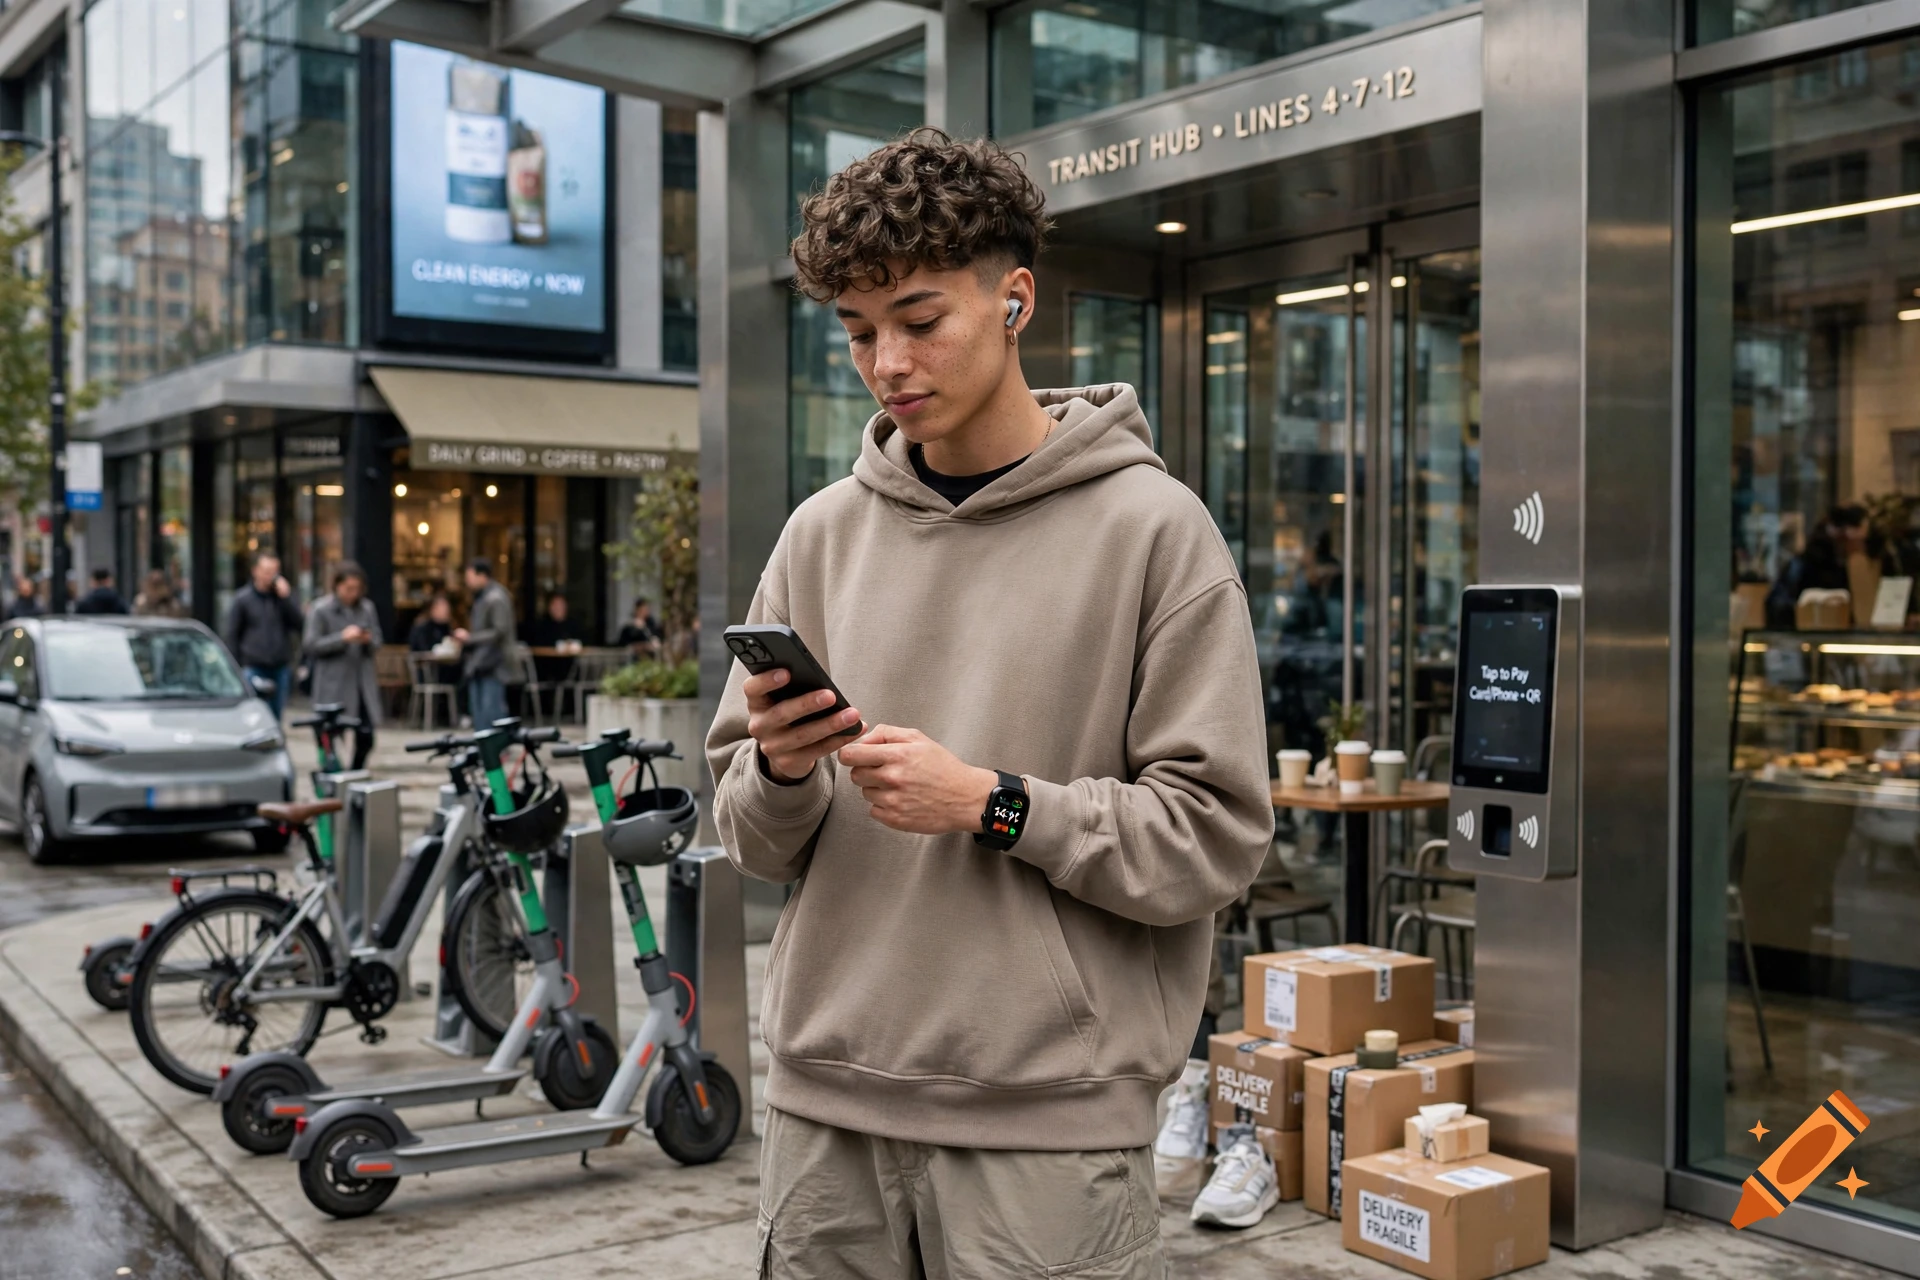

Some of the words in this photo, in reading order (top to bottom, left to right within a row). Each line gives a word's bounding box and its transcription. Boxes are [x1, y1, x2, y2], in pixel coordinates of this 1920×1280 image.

[1048, 138, 1142, 185] TRANSIT
[1150, 123, 1201, 160] HUB
[1235, 94, 1312, 138] LINES
[412, 258, 467, 285] CLEAN
[469, 263, 533, 291] ENERGY
[544, 271, 586, 296] NOW
[475, 445, 527, 467] GRIND
[541, 448, 599, 471] COFFEE
[1481, 665, 1499, 683] Tap
[1499, 667, 1510, 681] to
[1511, 666, 1529, 684] Pay
[1526, 688, 1541, 705] QR
[1216, 1065, 1274, 1097] DELIVERY
[1218, 1084, 1269, 1115] FRAGILE
[1363, 1196, 1424, 1232] DELIVERY
[1367, 1219, 1418, 1252] FRAGILE
